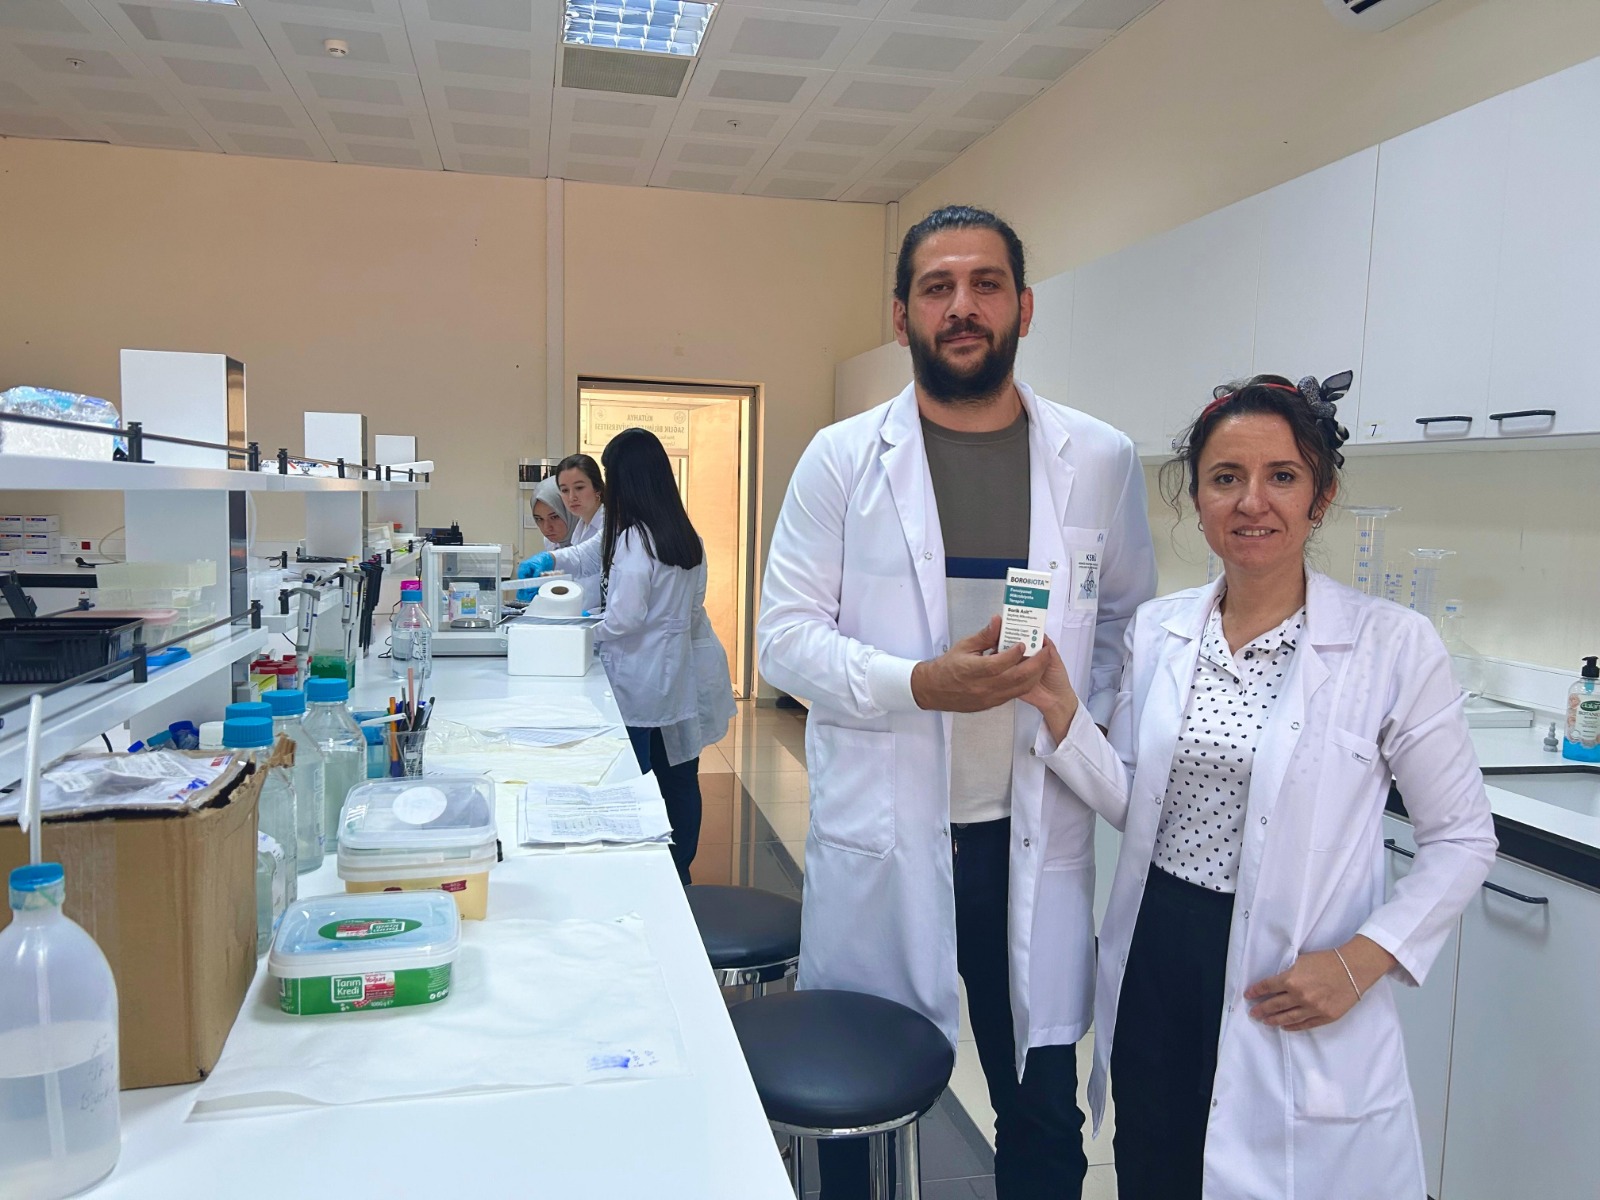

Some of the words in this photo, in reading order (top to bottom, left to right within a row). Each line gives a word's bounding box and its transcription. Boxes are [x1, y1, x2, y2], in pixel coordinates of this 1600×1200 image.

[1371, 424, 1378, 437] 7
[336, 979, 361, 987] Tarım
[337, 987, 360, 996] Kredi
